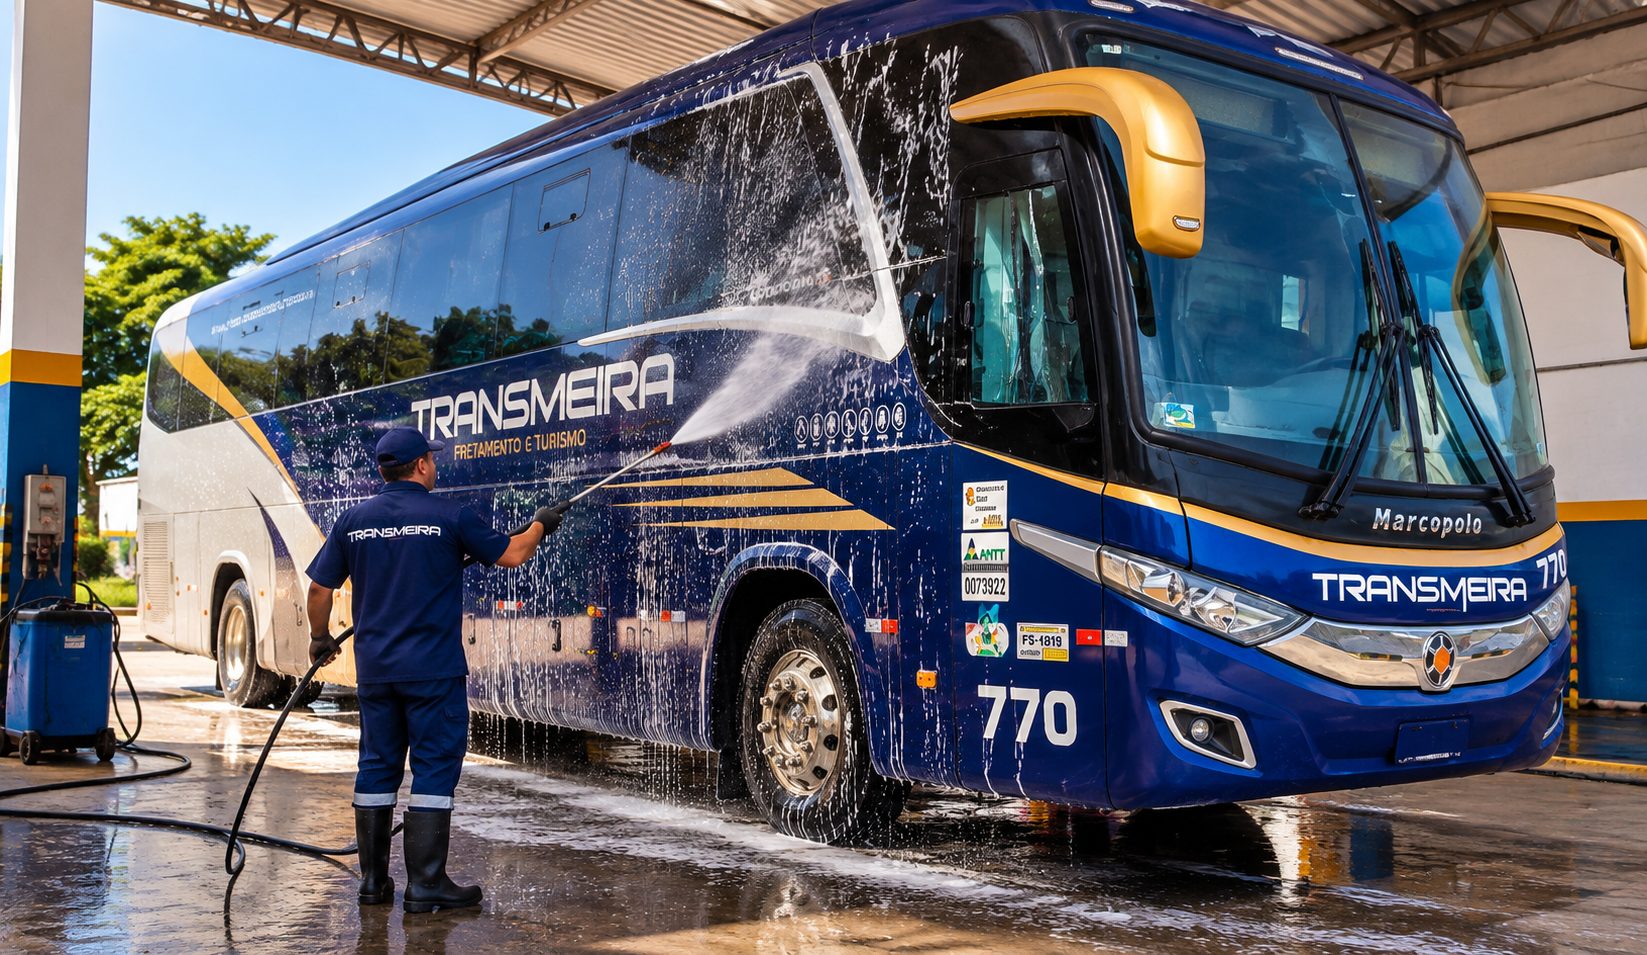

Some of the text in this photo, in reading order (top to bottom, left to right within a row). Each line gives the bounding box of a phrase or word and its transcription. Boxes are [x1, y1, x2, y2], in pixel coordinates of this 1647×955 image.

[411, 353, 674, 440] TRANSMEIRA
[454, 437, 522, 461] FRETAMENTO
[535, 428, 587, 451] TURISMO
[347, 525, 441, 543] TRANSMEIRA
[1372, 507, 1482, 539] Marcopolo
[980, 548, 1006, 561] ANTT
[1535, 548, 1567, 590] 770
[964, 577, 1006, 596] 0073922
[1312, 573, 1528, 613] TRANSMEIRA
[1022, 634, 1062, 648] FS-1819
[977, 684, 1077, 746] 770
